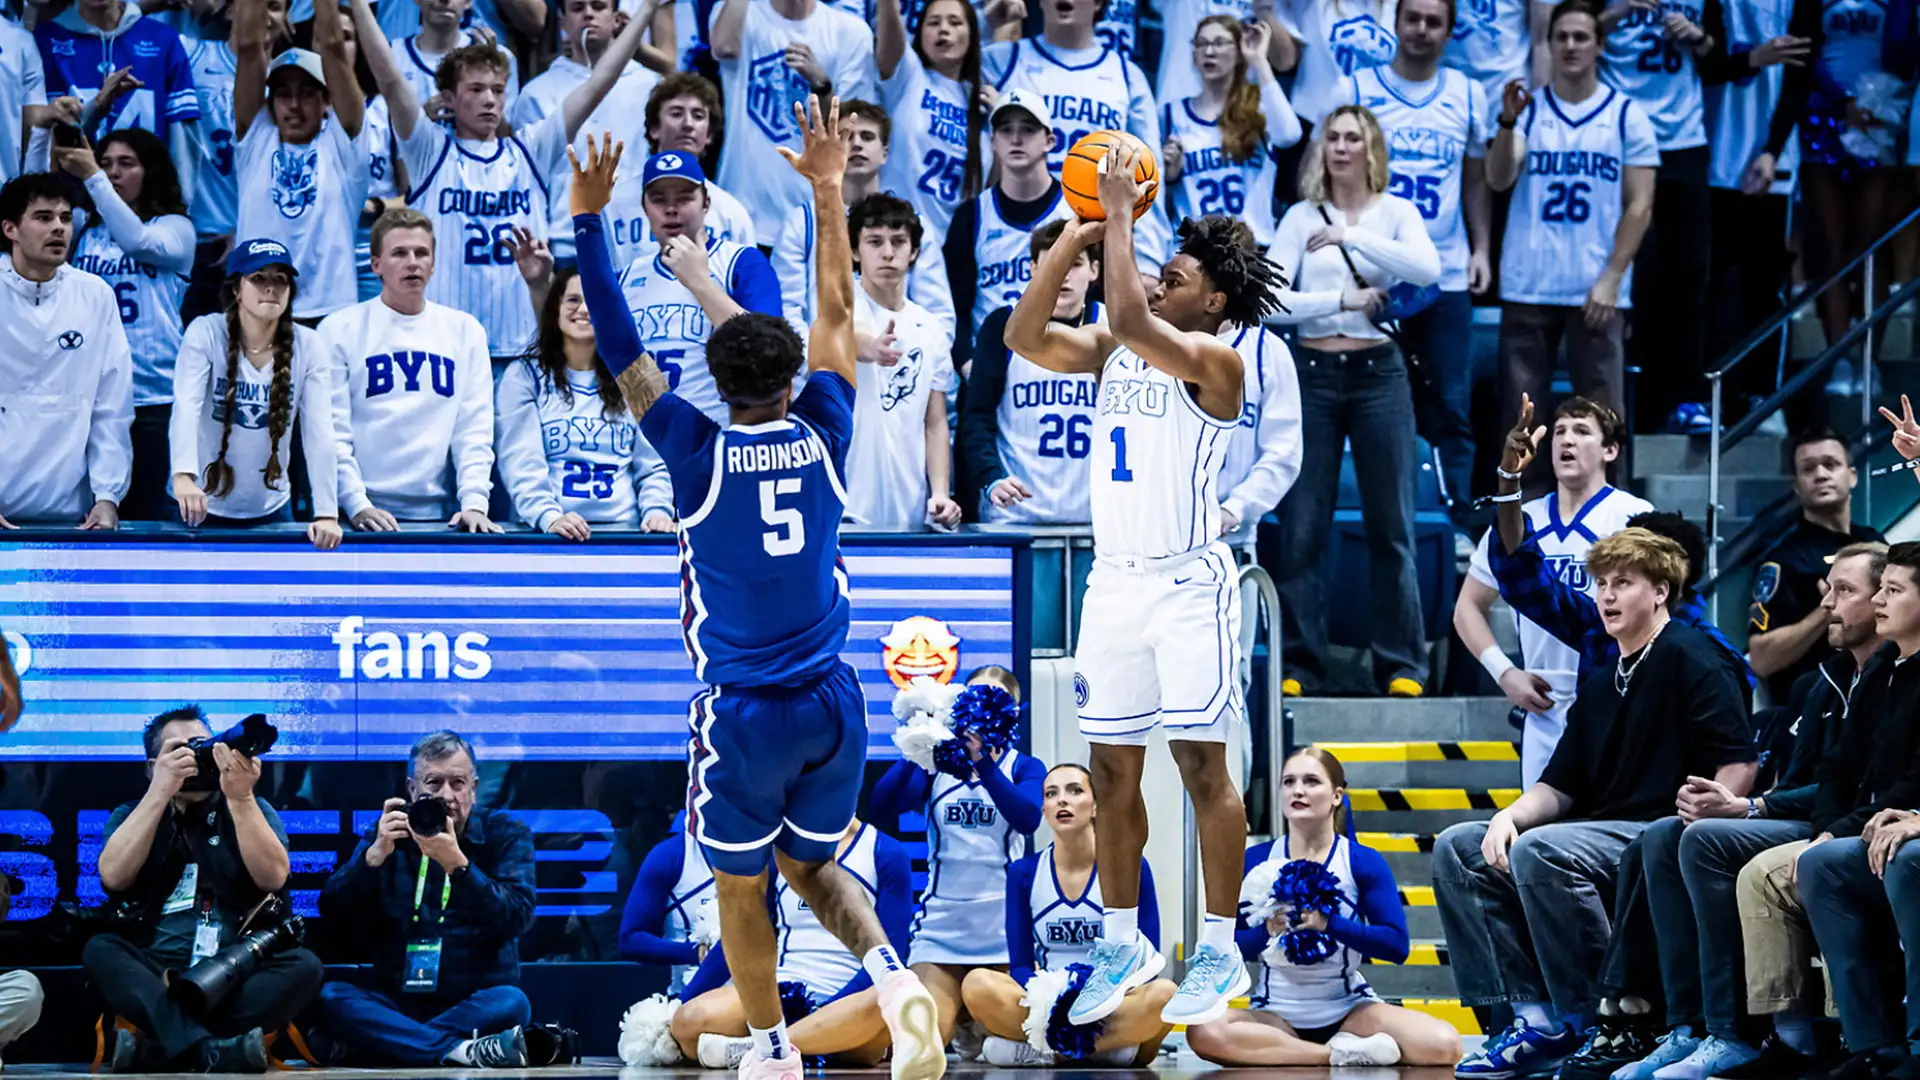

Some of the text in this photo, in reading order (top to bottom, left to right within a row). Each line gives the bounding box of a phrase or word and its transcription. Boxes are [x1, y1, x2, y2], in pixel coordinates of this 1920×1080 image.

[1637, 32, 1682, 74] 26
[1043, 95, 1121, 131] UGARS
[918, 148, 966, 201] 25
[1527, 150, 1620, 182] COUGARS
[1196, 173, 1244, 215] 26
[1541, 181, 1592, 223] 26
[463, 222, 516, 266] 26
[981, 256, 1033, 289] COUG
[365, 350, 456, 399] BYU
[645, 348, 686, 393] 5
[1101, 379, 1168, 418] BYU
[541, 415, 637, 459] BYU
[728, 436, 822, 473] ROBINSON
[1038, 412, 1092, 460] 26
[1110, 426, 1134, 482] 1
[561, 460, 619, 500] 25
[759, 478, 805, 557] 5
[331, 615, 493, 680] fans
[945, 799, 996, 829] BYU
[1048, 917, 1103, 946] BYU
